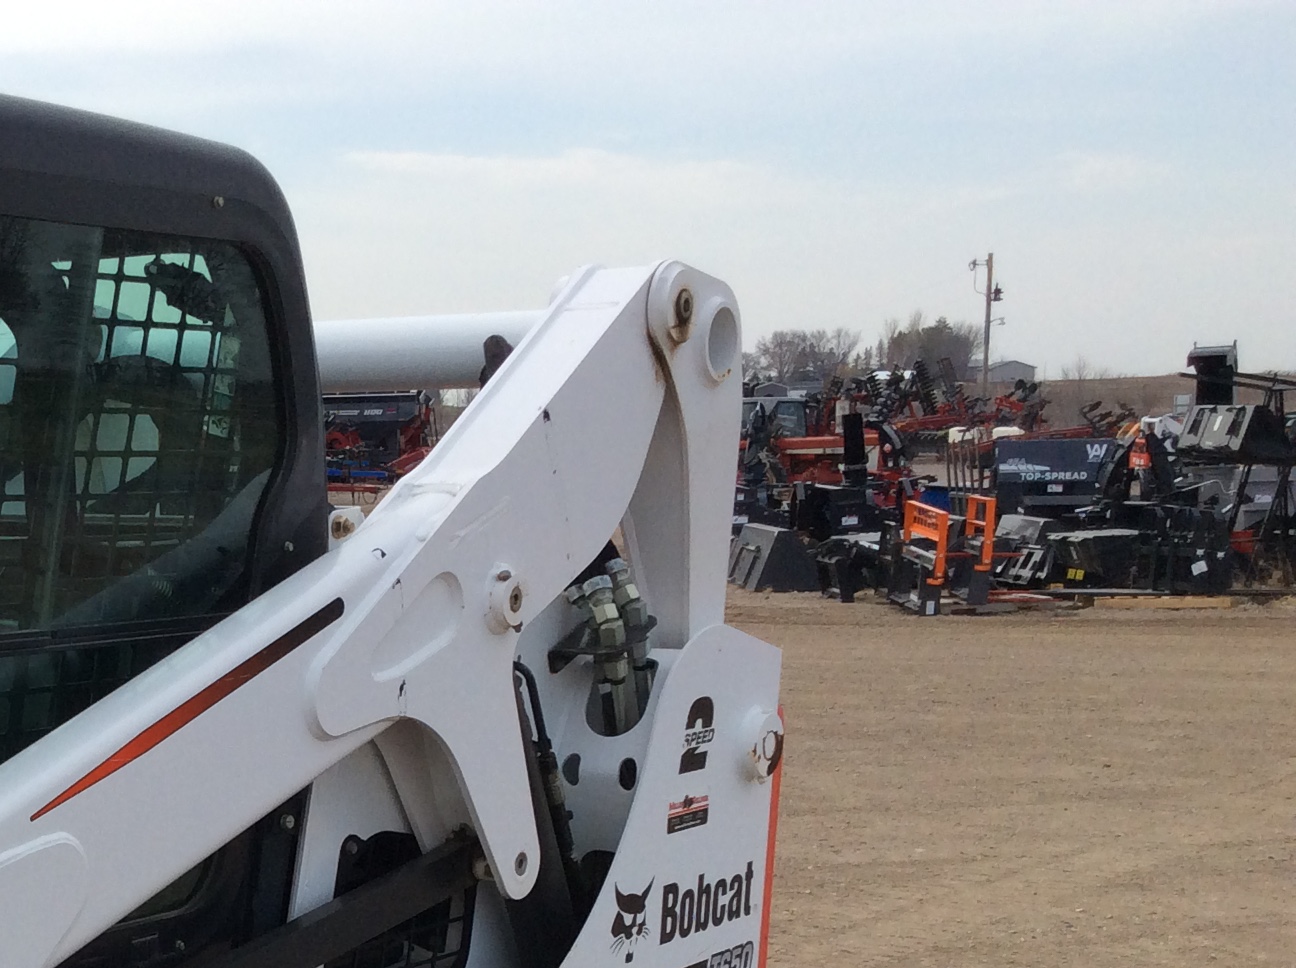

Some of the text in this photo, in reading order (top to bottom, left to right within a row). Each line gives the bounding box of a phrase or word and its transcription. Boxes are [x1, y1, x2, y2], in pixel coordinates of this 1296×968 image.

[1020, 471, 1088, 481] TOP-SPREAD
[684, 727, 715, 747] SPEED
[660, 861, 754, 945] Bobcat
